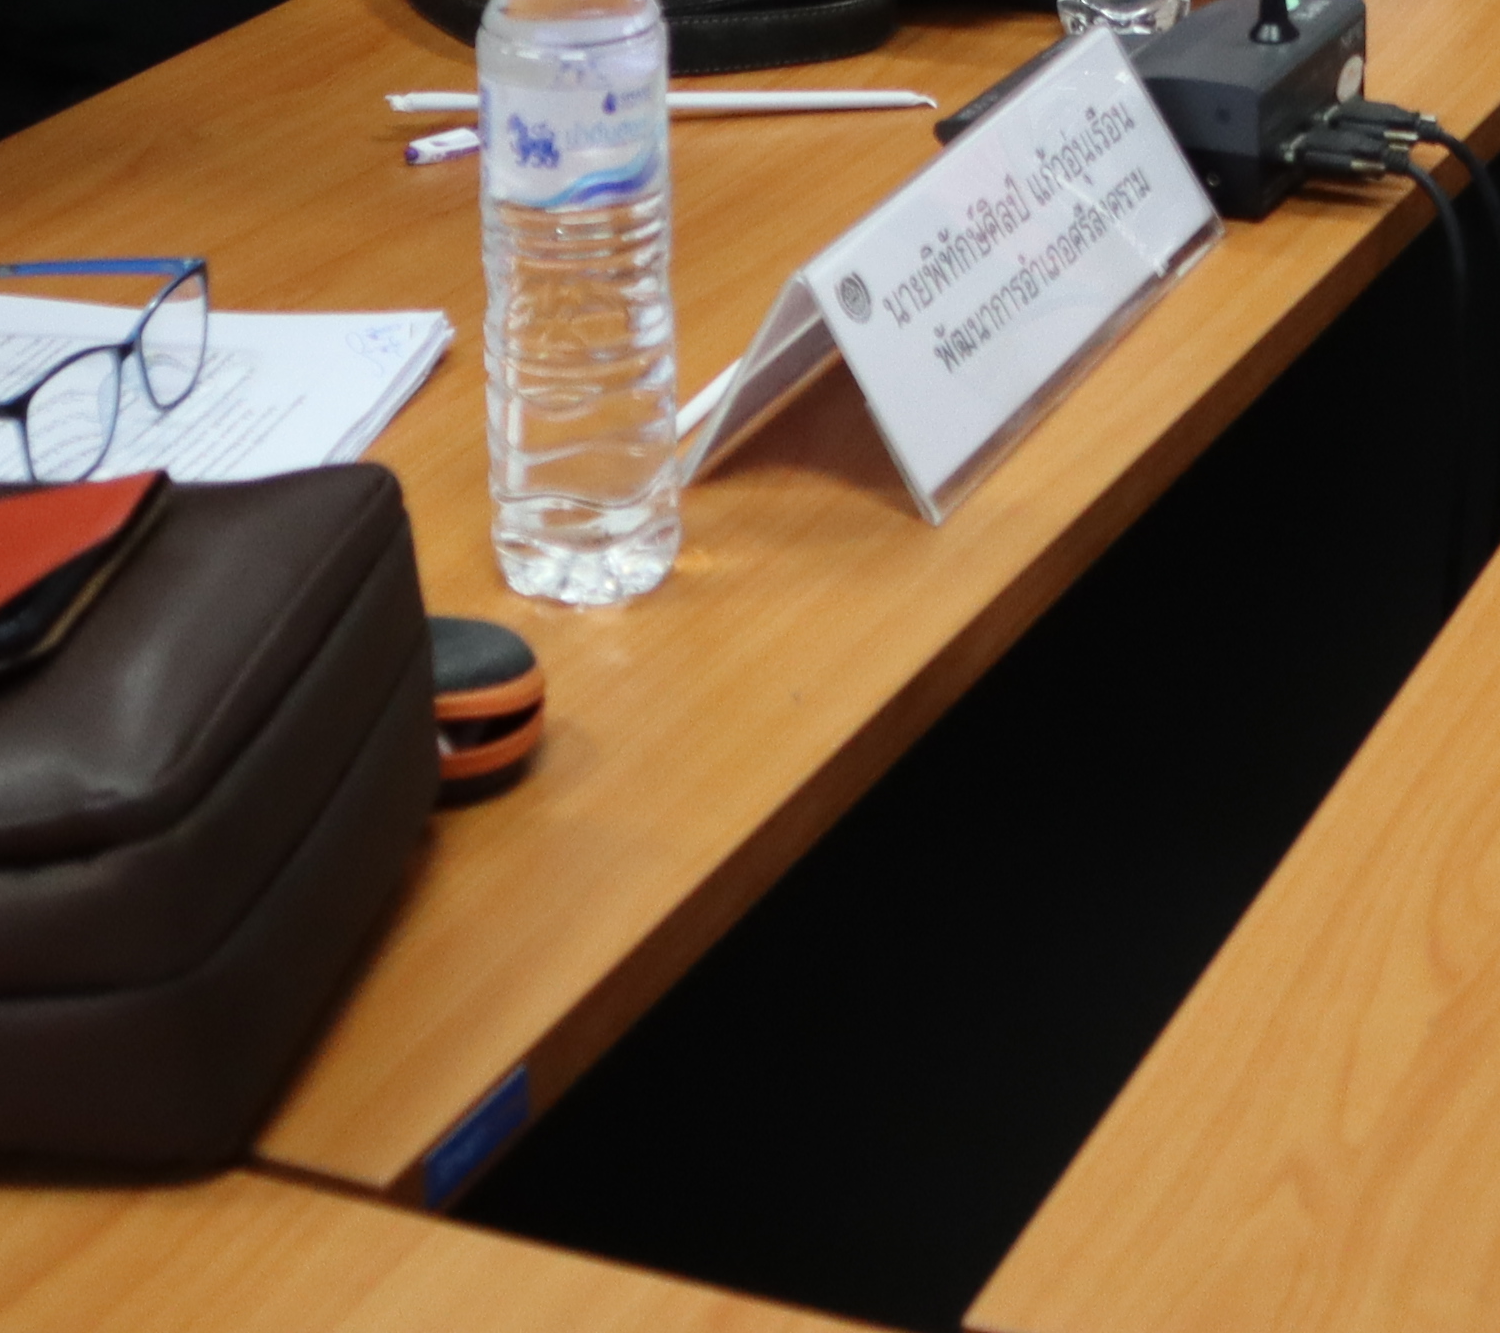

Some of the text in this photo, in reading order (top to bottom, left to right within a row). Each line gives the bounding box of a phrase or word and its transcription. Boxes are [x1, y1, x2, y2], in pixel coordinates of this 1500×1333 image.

[882, 97, 1138, 331] นายพิทักษ์ศิลป์ แก้วอุ่นเรือน
[930, 165, 1153, 377] พัฒนาการอำเภอศรีสงคราม
